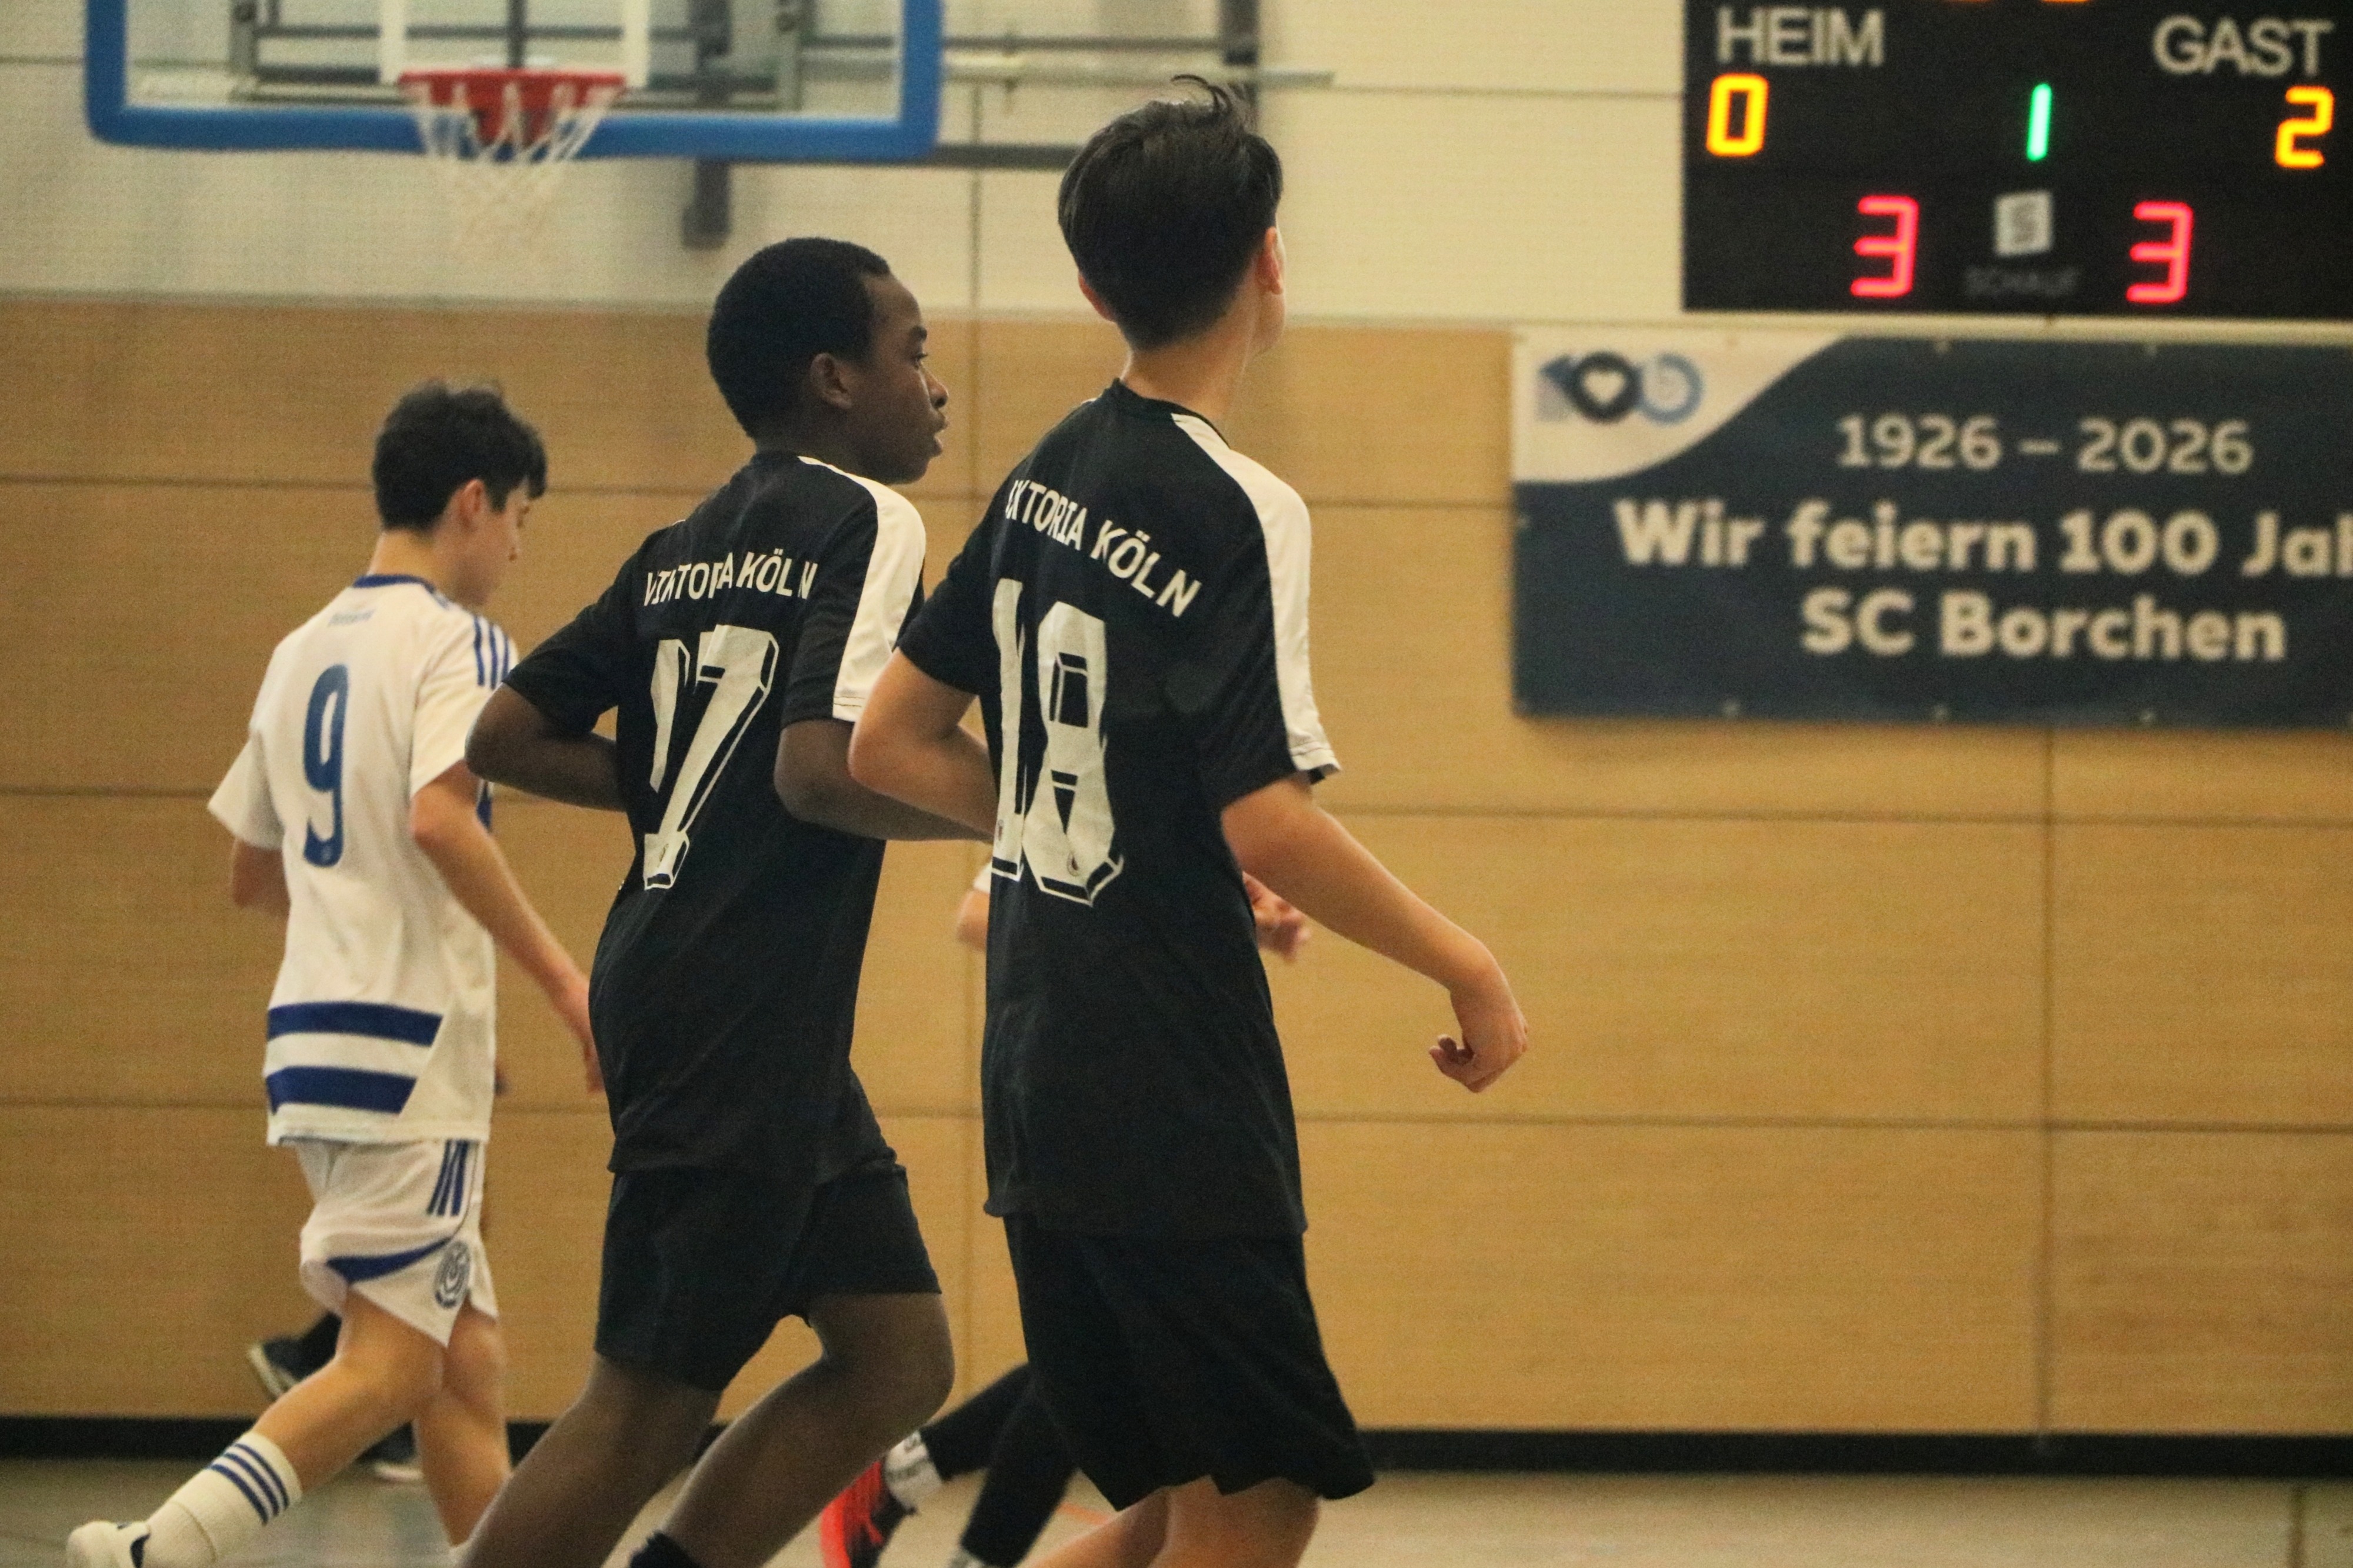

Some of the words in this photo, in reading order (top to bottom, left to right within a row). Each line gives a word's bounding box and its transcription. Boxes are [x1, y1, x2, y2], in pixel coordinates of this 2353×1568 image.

[1717, 6, 1884, 66] HEIM
[2152, 15, 2334, 76] GAST
[1706, 73, 1769, 157] 0
[2026, 82, 2053, 162] 1
[2274, 85, 2335, 169] 2
[1850, 195, 1920, 298] 3
[2126, 201, 2195, 304] 3
[1840, 415, 2002, 470] 1926
[2077, 418, 2254, 474] 2026
[736, 548, 818, 600] KÖLN
[1089, 519, 1203, 618] KÖLN
[1614, 499, 1764, 566] Wir
[1786, 500, 2037, 571] feiern
[2060, 510, 2219, 575] 100
[1801, 588, 1914, 655] SC
[1939, 591, 2286, 660] Borchen
[303, 663, 349, 868] 9
[643, 624, 779, 890] 17
[991, 578, 1124, 908] 18
